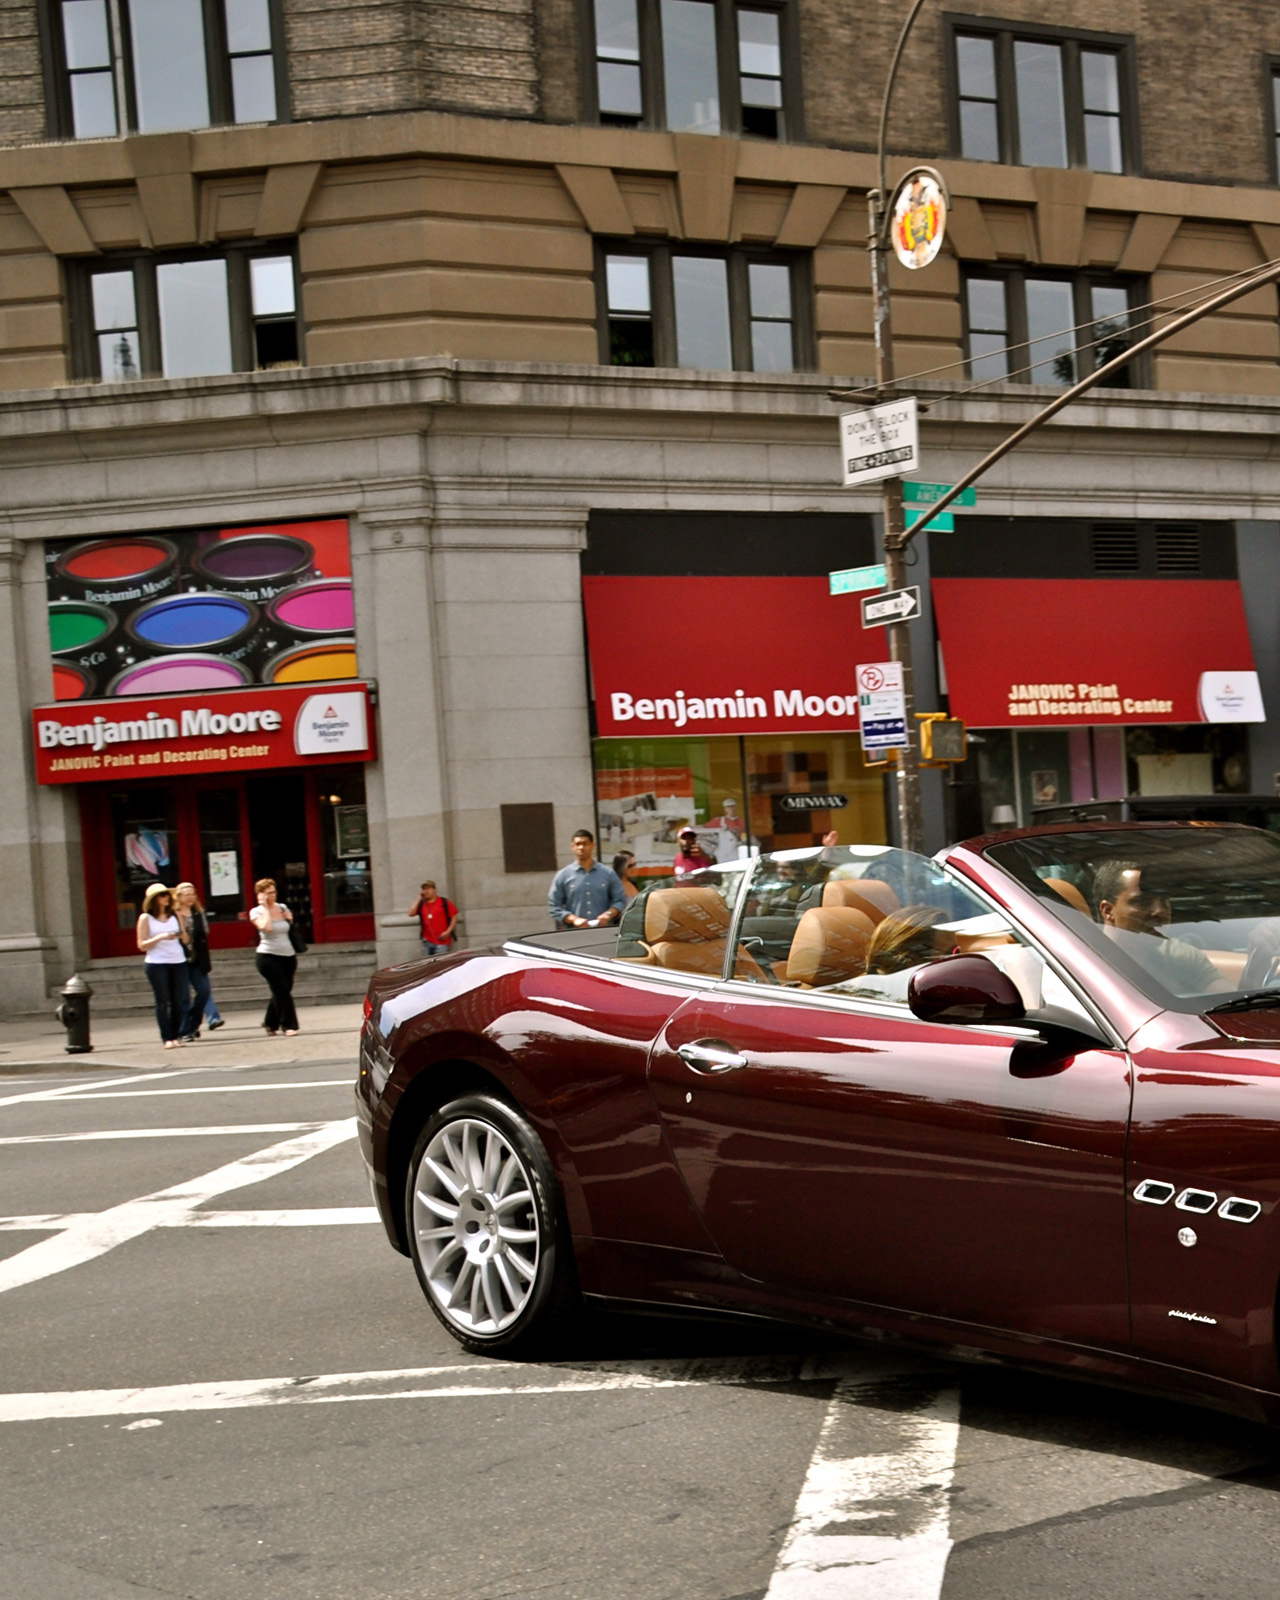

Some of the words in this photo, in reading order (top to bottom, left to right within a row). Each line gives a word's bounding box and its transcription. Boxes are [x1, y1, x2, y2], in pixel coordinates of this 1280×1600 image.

[847, 419, 874, 435] DON'T
[878, 411, 908, 428] BLOCK
[859, 432, 876, 446] THE
[880, 429, 898, 442] BOX
[85, 587, 141, 605] Benjamin
[871, 603, 886, 616] ONE
[894, 599, 909, 611] WAY
[1008, 684, 1075, 699] JANOVIC
[1078, 684, 1119, 699] Paint
[610, 689, 767, 727] Benjamin
[773, 689, 858, 717] Moor
[1009, 700, 1037, 715] and
[1039, 700, 1122, 715] Decorating
[1123, 698, 1173, 713] Center
[38, 711, 178, 751] Benjamin
[181, 708, 282, 737] Moore
[312, 721, 349, 730] Benjamin
[50, 756, 101, 771] JANOVIC
[104, 754, 135, 767] Paint
[139, 752, 160, 764] and
[163, 747, 227, 763] Decorating
[229, 745, 269, 758] Center
[786, 795, 843, 808] MINWAX
